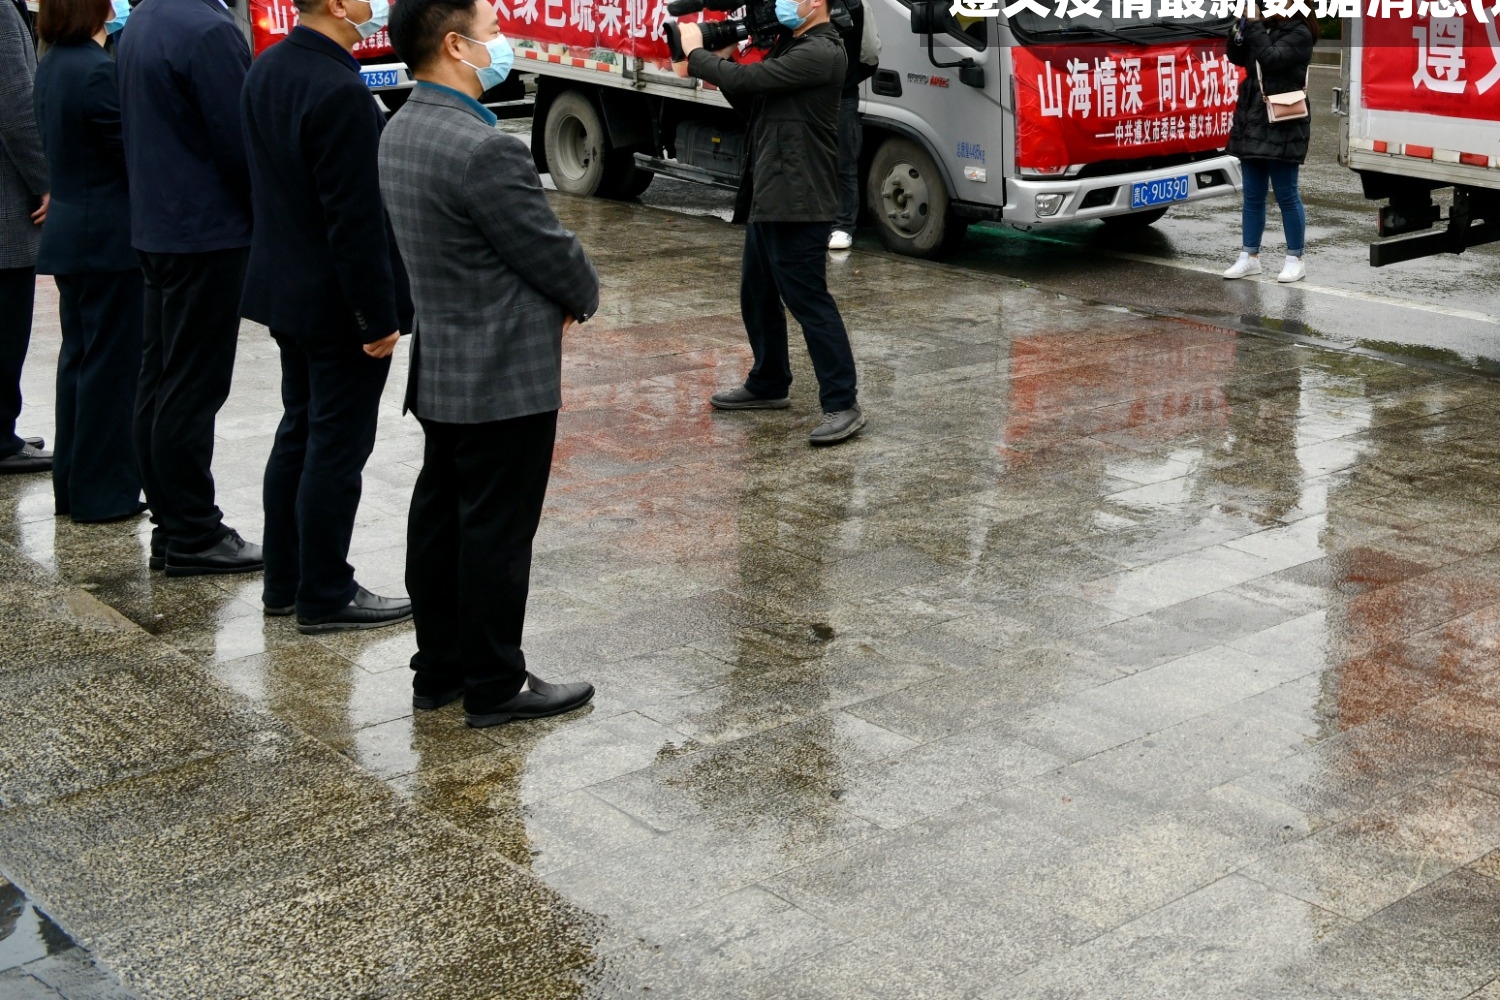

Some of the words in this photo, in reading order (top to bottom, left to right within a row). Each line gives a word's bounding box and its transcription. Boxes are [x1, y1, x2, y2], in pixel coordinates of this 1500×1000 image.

[363, 72, 397, 87] 7336V
[1037, 56, 1143, 119] 山海情深
[1157, 50, 1239, 113] 同心抗疫
